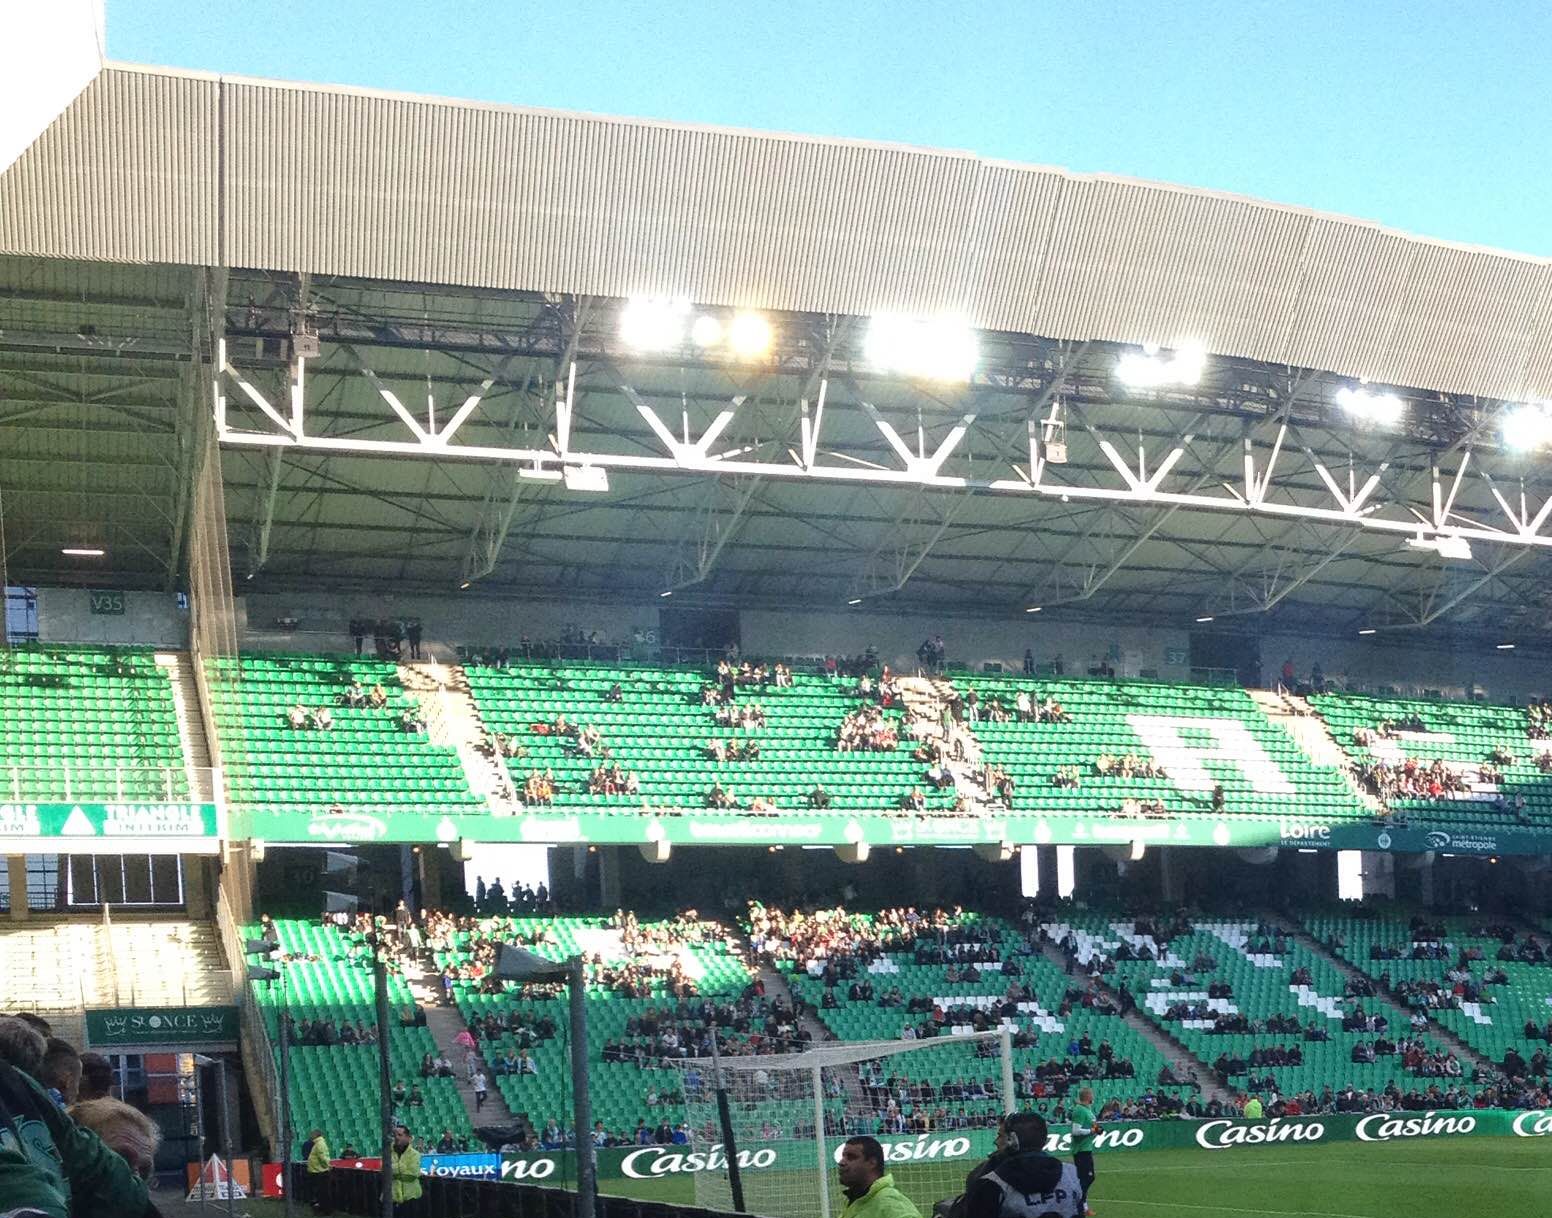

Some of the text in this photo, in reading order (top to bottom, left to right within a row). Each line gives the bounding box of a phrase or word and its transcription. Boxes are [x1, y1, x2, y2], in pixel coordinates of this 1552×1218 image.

[1280, 818, 1331, 840] Loire
[1195, 1117, 1325, 1149] Casino
[1355, 1111, 1476, 1141] Casino
